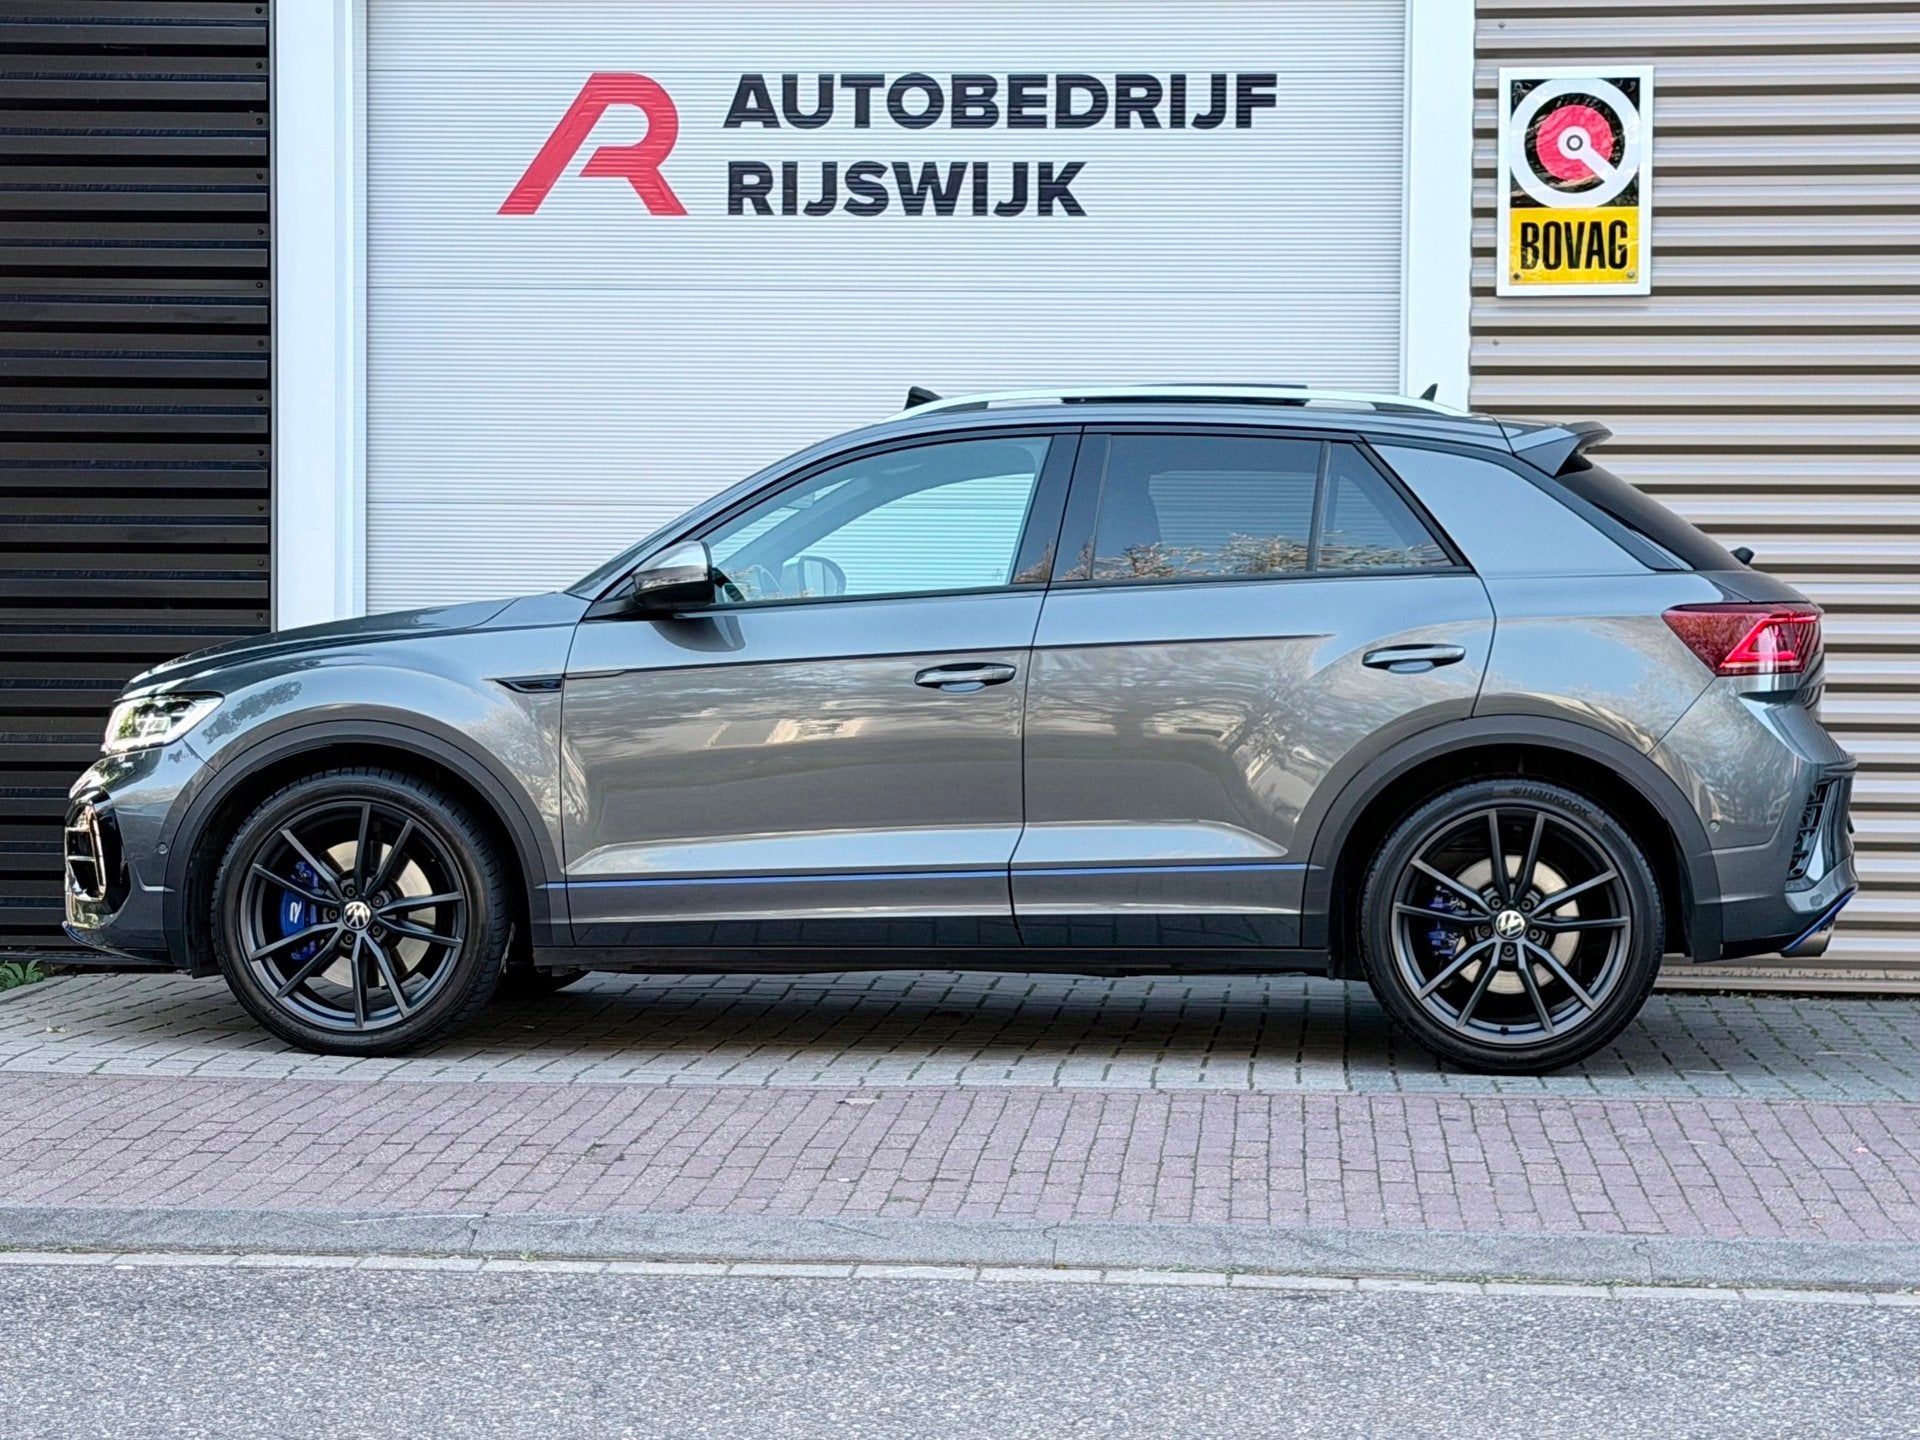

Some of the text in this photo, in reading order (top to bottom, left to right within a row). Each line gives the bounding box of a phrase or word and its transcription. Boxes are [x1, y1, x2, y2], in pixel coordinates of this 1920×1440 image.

[723, 73, 1277, 129] AUTOBEDRIJF
[727, 161, 1087, 217] RIJSWIJK
[1520, 220, 1628, 270] BOVAG
